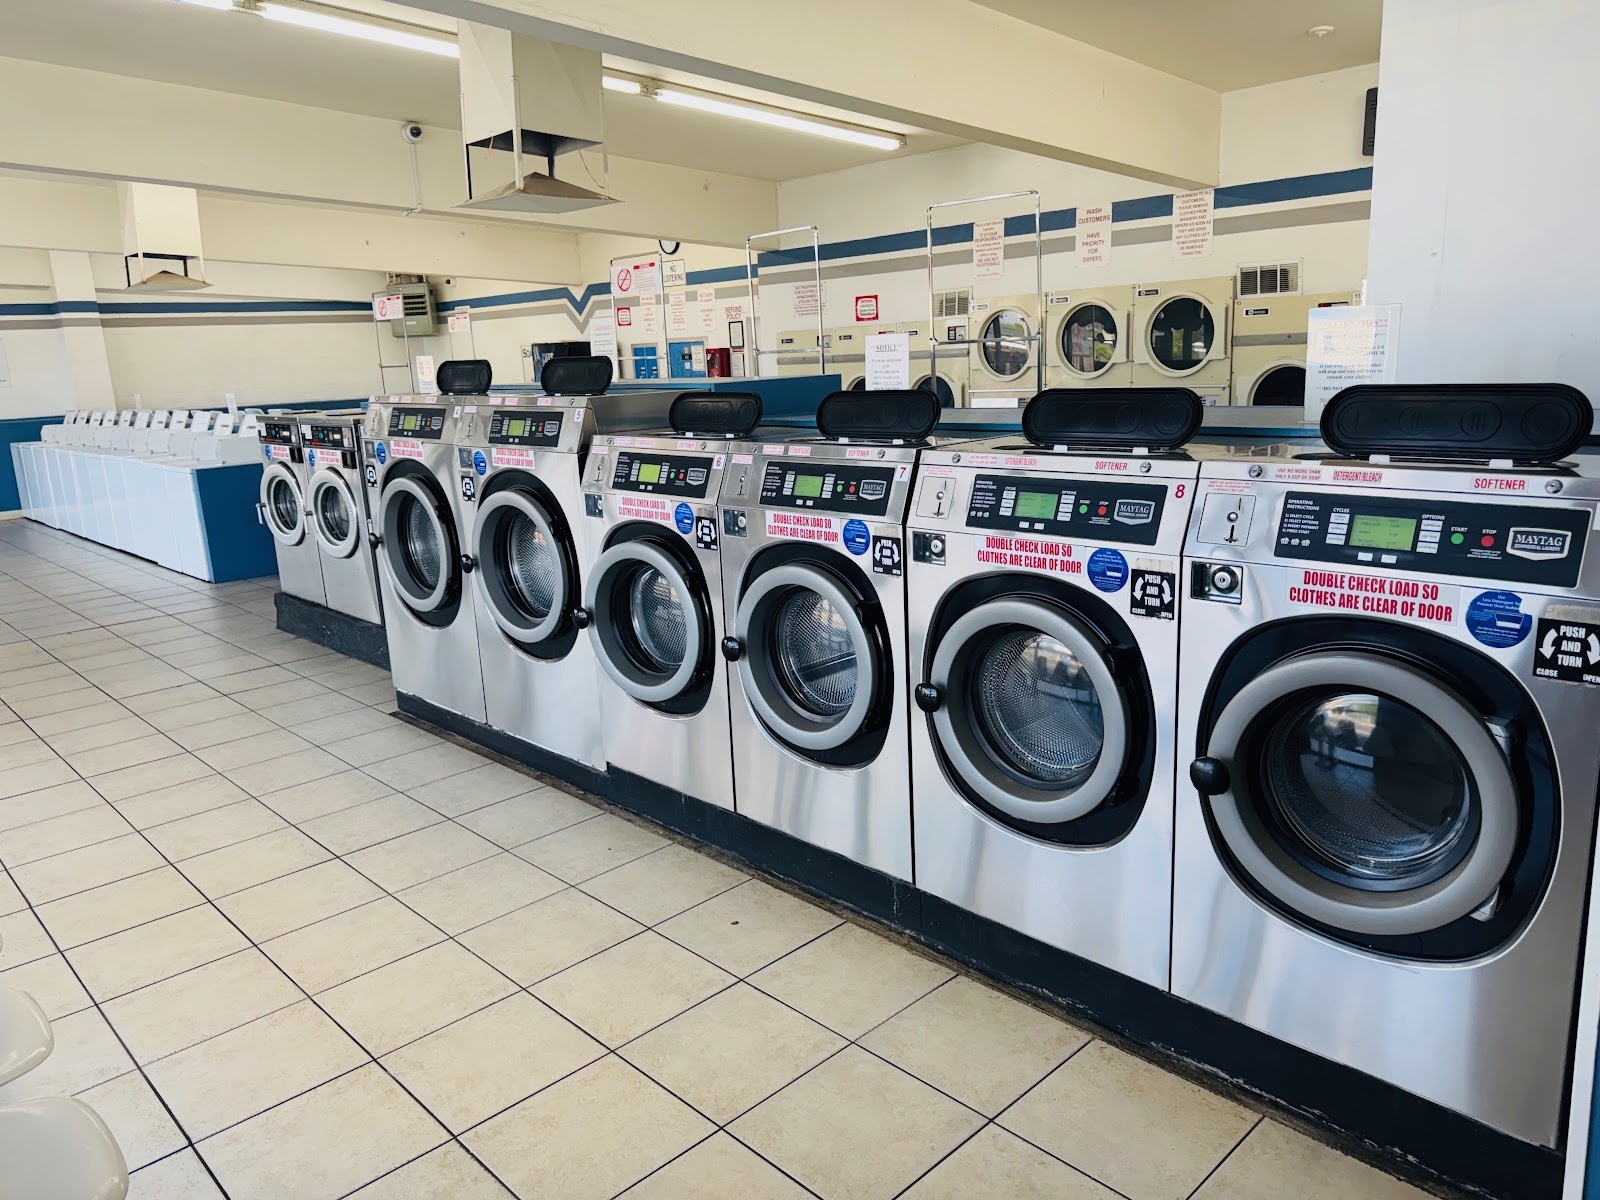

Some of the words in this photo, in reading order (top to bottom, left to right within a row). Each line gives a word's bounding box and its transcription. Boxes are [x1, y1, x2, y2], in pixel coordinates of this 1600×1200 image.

[1078, 215, 1110, 224] CUSTOMERS
[664, 273, 684, 282] LOITERING
[577, 411, 580, 420] 5
[716, 458, 721, 466] 6
[1095, 461, 1128, 470] SOFTENER
[900, 467, 906, 478] 7
[1333, 471, 1382, 482] DETERGENT/BLEACH
[1474, 478, 1525, 490] SOFTENER
[1175, 484, 1186, 498] 8
[622, 497, 635, 506] DOUBLE
[637, 498, 649, 508] CHECK
[650, 500, 660, 509] LOAD
[660, 501, 665, 510] SO
[1120, 505, 1150, 513] MAYTAG
[619, 507, 634, 517] CLOTHES
[643, 510, 654, 519] CLEAR
[655, 511, 660, 519] OF
[660, 512, 671, 521] DOOR
[774, 514, 791, 524] DOUBLE
[793, 516, 809, 526] CHECK
[811, 518, 823, 527] LOAD
[825, 518, 831, 529] SO
[768, 525, 788, 536] CLOTHES
[790, 528, 799, 537] ARE
[800, 529, 815, 539] CLEAR
[817, 530, 823, 540] OF
[824, 531, 838, 542] DOOR
[1515, 534, 1563, 546] MAYTAG
[986, 537, 1012, 550] DOUBLE
[1014, 540, 1038, 553] CHECK
[1041, 542, 1059, 556] LOAD
[1062, 544, 1072, 557] SO
[978, 550, 1007, 564] CLOTHES
[1009, 554, 1022, 566] ARE
[1024, 555, 1046, 569] CLEAR
[1049, 558, 1058, 570] OF
[1060, 559, 1081, 574] DOOR
[1145, 574, 1161, 584] PUSH
[1146, 586, 1158, 595] AND
[1304, 570, 1345, 589] DOUBLE
[1348, 575, 1386, 594] CHECK
[1389, 580, 1419, 598] LOAD
[1422, 584, 1439, 601] SO
[1144, 597, 1160, 607] TURN
[1289, 587, 1336, 607] CLOTHES
[1338, 593, 1360, 609] ARE
[1362, 596, 1397, 615] CLEAR
[1401, 601, 1415, 617] OF
[1418, 603, 1452, 622] DOOR
[1560, 625, 1586, 638] PUSH
[1561, 640, 1581, 652] AND
[1557, 654, 1582, 668] TURN
[1536, 668, 1558, 677] CLOSE
[1583, 674, 1600, 684] OPEN
